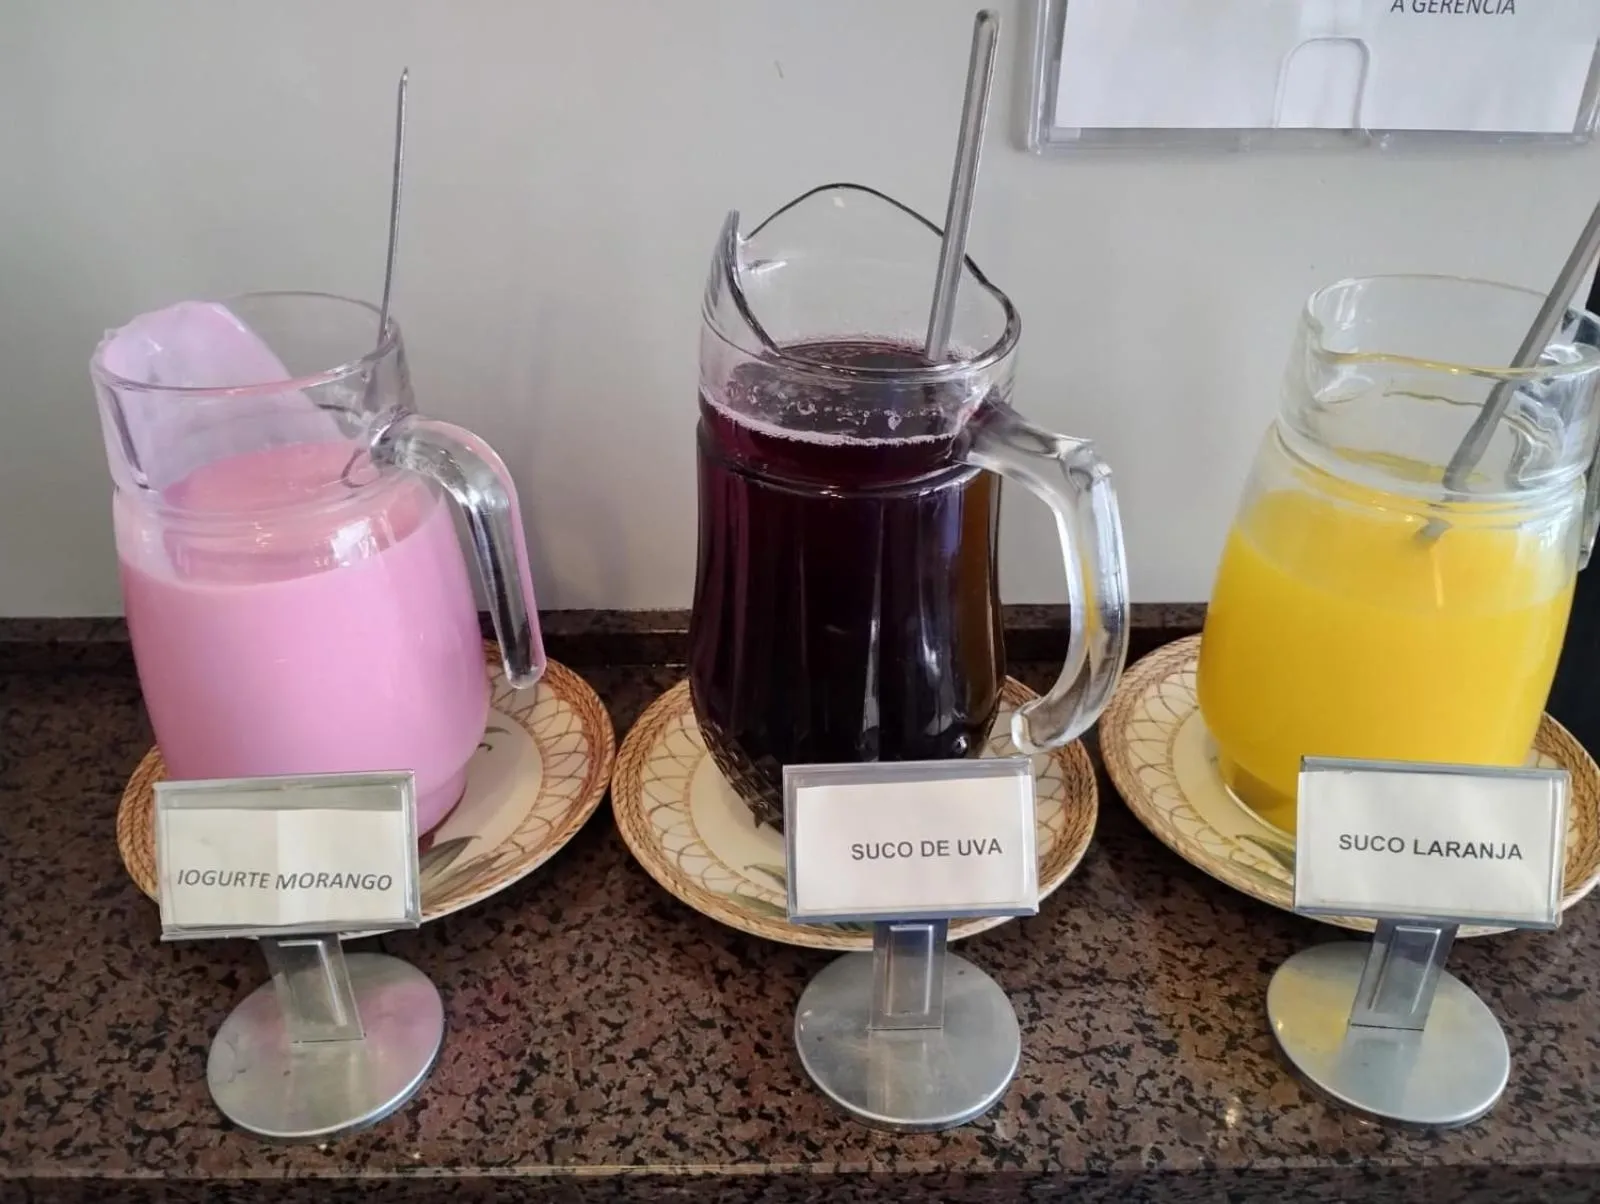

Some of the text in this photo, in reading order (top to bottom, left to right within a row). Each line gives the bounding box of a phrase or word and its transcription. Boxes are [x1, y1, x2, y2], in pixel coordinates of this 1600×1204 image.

[1390, 0, 1405, 13] A
[851, 838, 1003, 860] SUCO DE UVA
[1338, 834, 1523, 860] SUCO LARANJA
[177, 869, 393, 891] IOGURTE MORANGO
